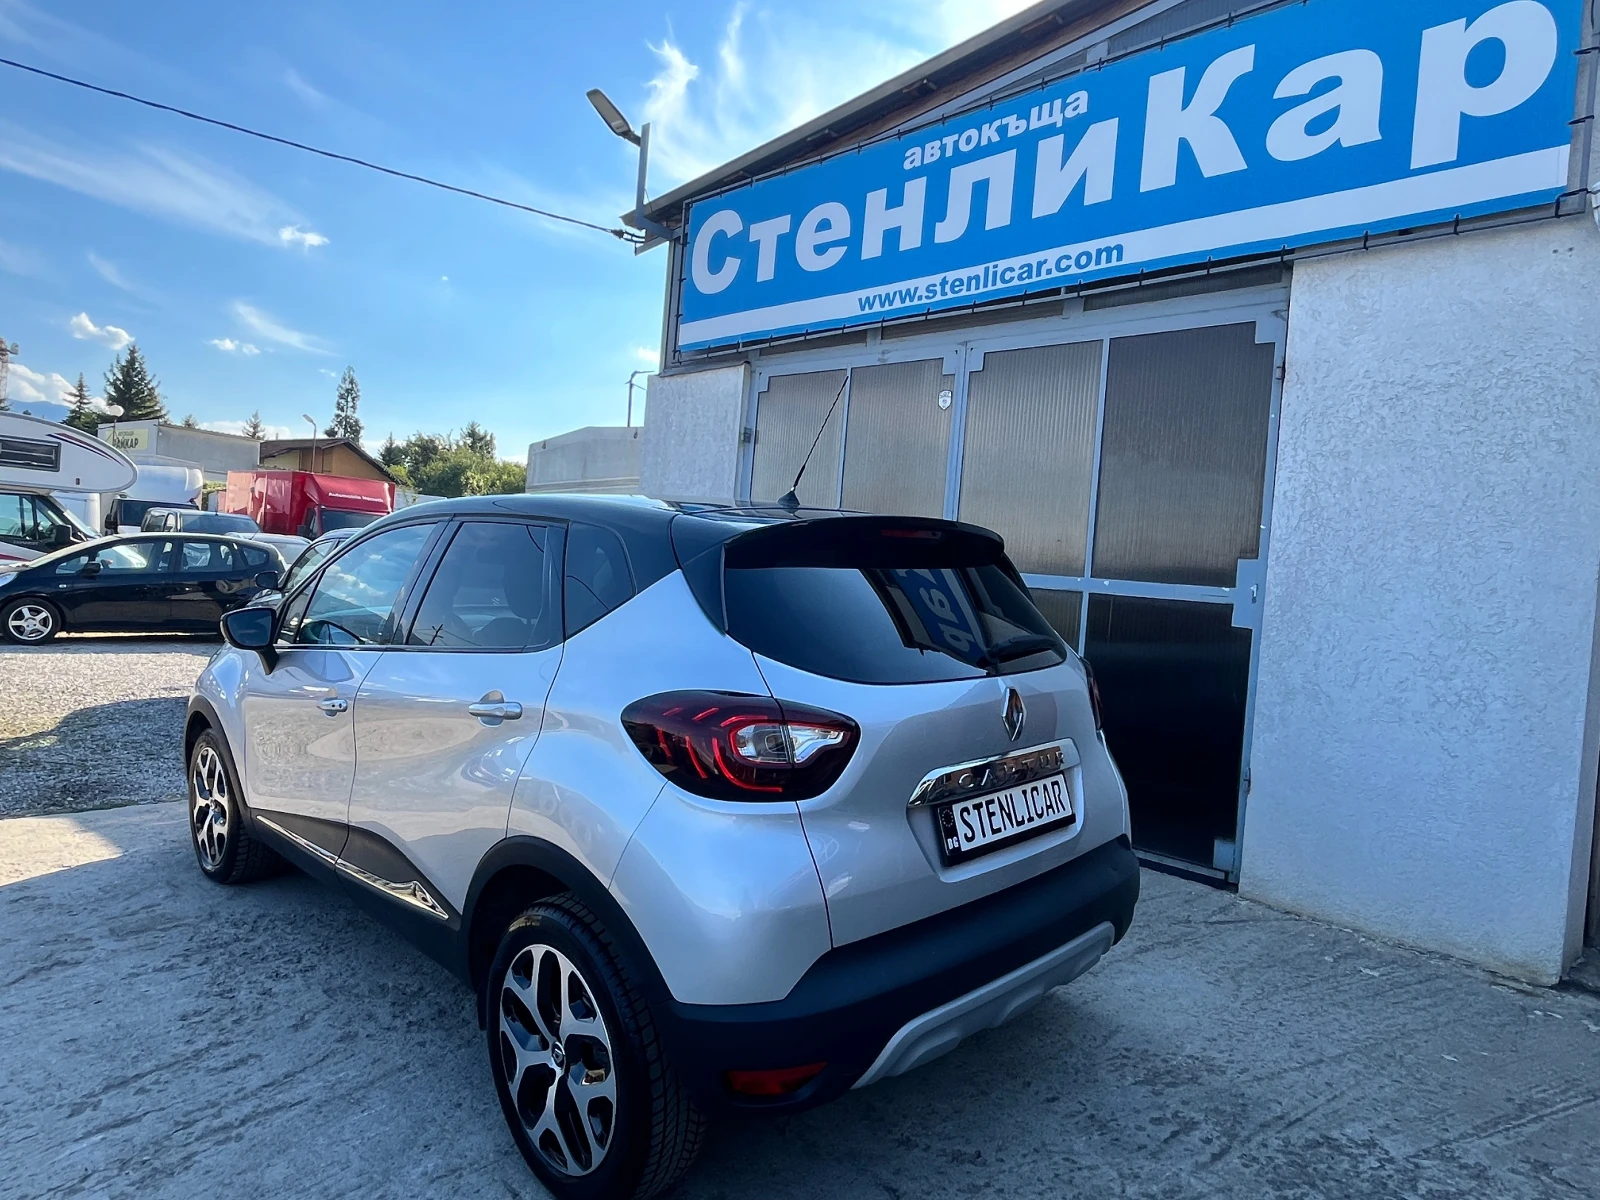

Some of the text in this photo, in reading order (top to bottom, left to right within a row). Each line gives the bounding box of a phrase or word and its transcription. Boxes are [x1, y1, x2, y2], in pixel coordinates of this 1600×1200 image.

[691, 0, 1558, 295] СтенлиКар
[903, 90, 1088, 170] автокъща
[858, 243, 1124, 312] www.stenlicar.com
[959, 779, 1067, 844] STENLICAR
